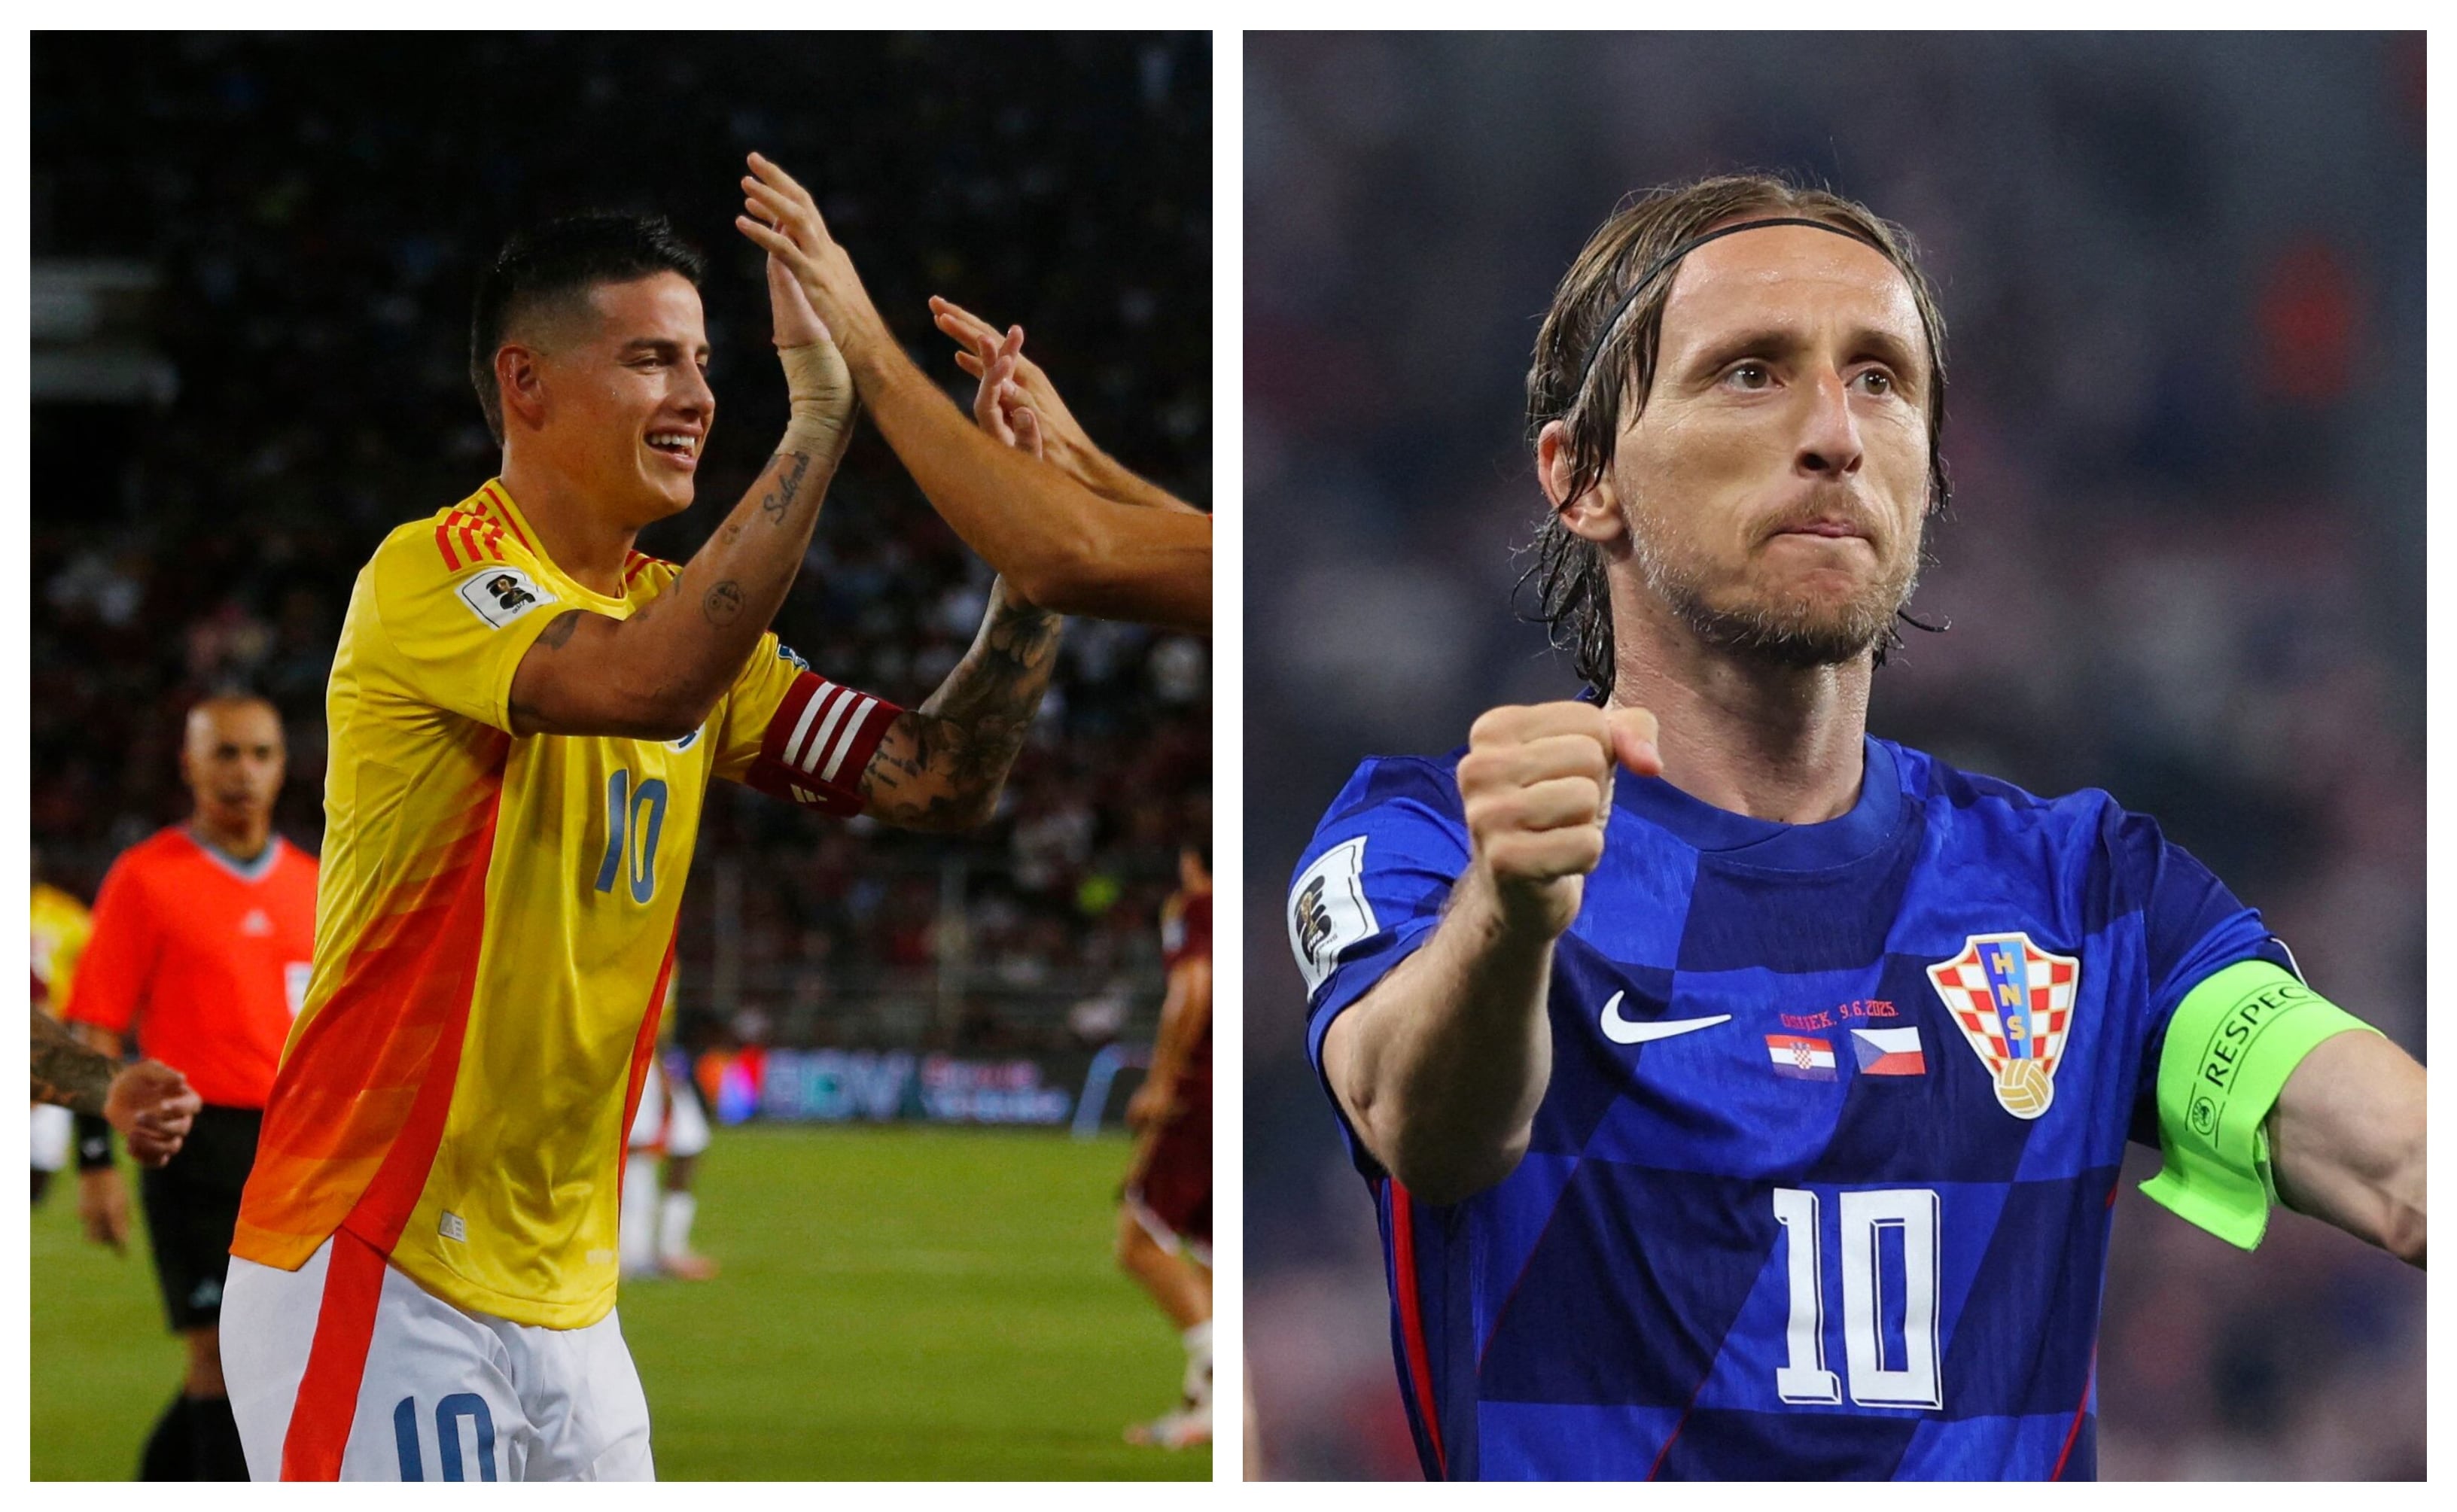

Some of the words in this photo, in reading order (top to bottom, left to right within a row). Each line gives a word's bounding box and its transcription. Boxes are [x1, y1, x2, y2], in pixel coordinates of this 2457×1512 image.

[594, 768, 668, 904] 10
[1992, 951, 2026, 1041] HNS
[2205, 986, 2311, 1088] RESPEC
[1773, 1187, 1943, 1410] 10
[393, 1392, 498, 1482] 10
